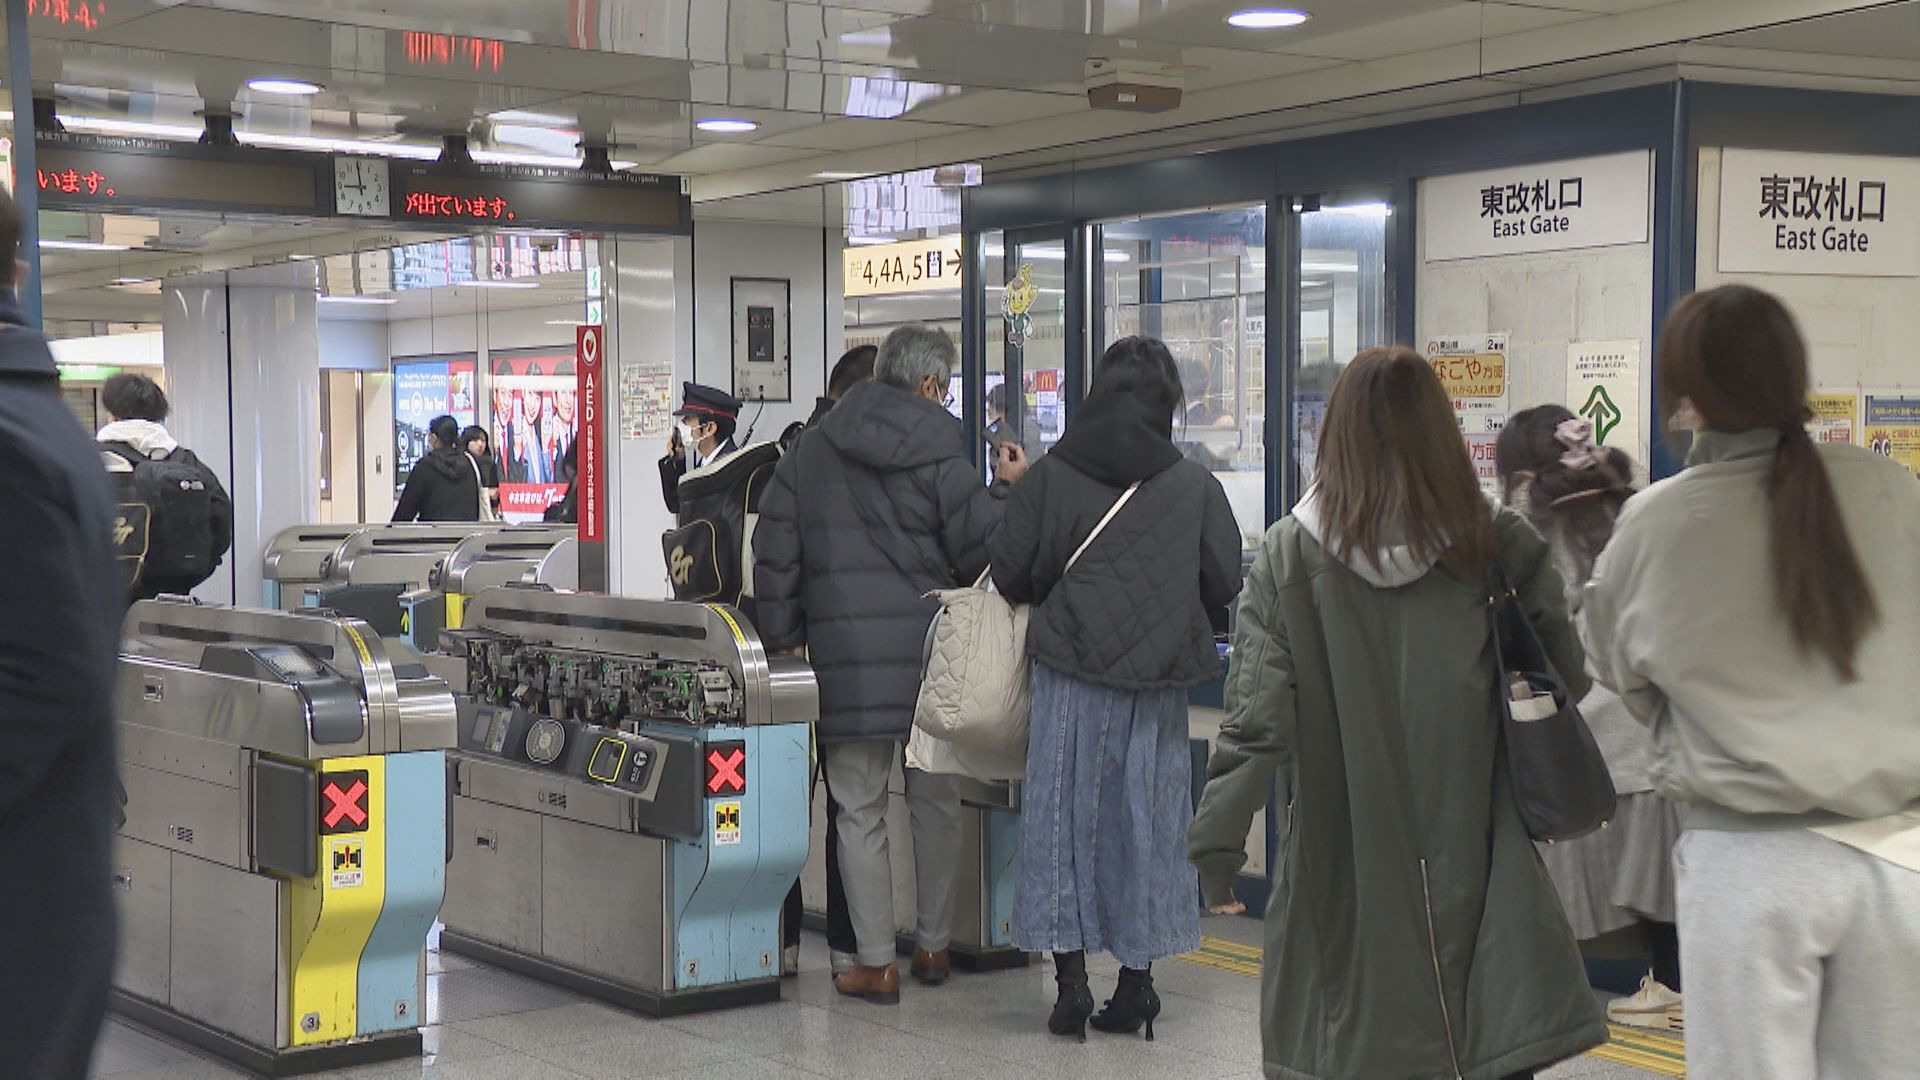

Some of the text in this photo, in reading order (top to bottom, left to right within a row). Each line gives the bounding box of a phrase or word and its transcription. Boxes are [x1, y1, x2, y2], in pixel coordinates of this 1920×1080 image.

[36, 169, 116, 196] います。
[405, 193, 515, 220] が出ています。
[1480, 177, 1583, 218] 東改札口
[1759, 172, 1886, 222] 東改札口
[1493, 214, 1569, 238] East Gate
[1775, 224, 1869, 252] East Gate
[862, 253, 923, 289] 4,4A,5
[585, 372, 595, 422] AED
[306, 1016, 316, 1029] 3
